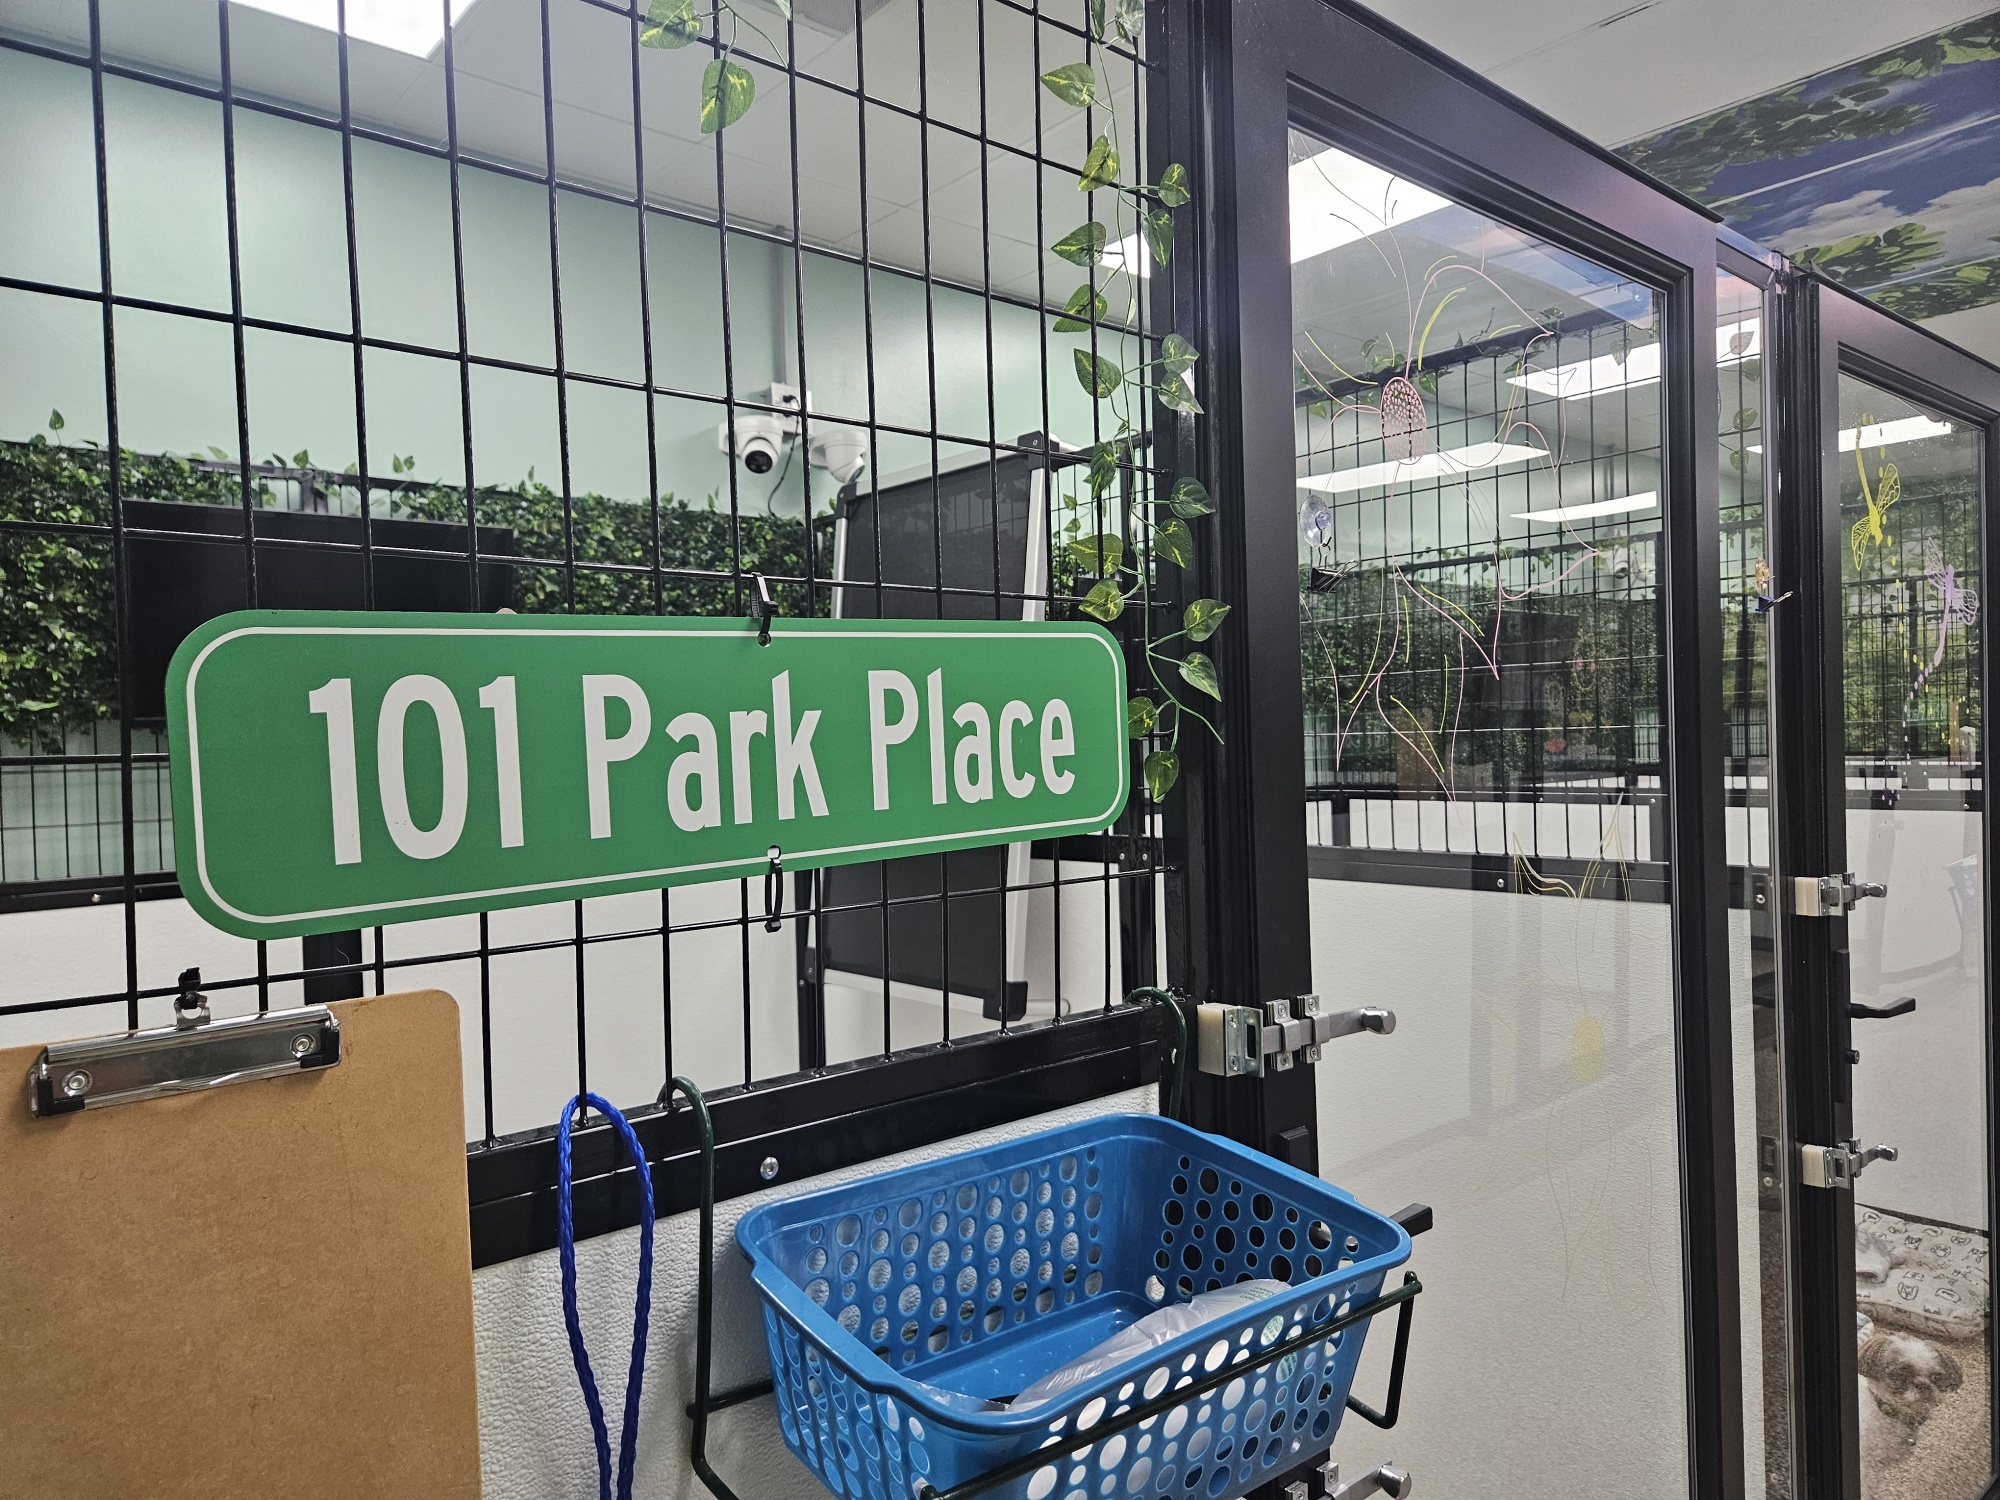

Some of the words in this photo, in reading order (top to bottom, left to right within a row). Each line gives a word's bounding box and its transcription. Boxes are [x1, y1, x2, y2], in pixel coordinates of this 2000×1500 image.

[308, 674, 526, 866] 101
[582, 669, 830, 840] Park
[867, 667, 1077, 811] Place
